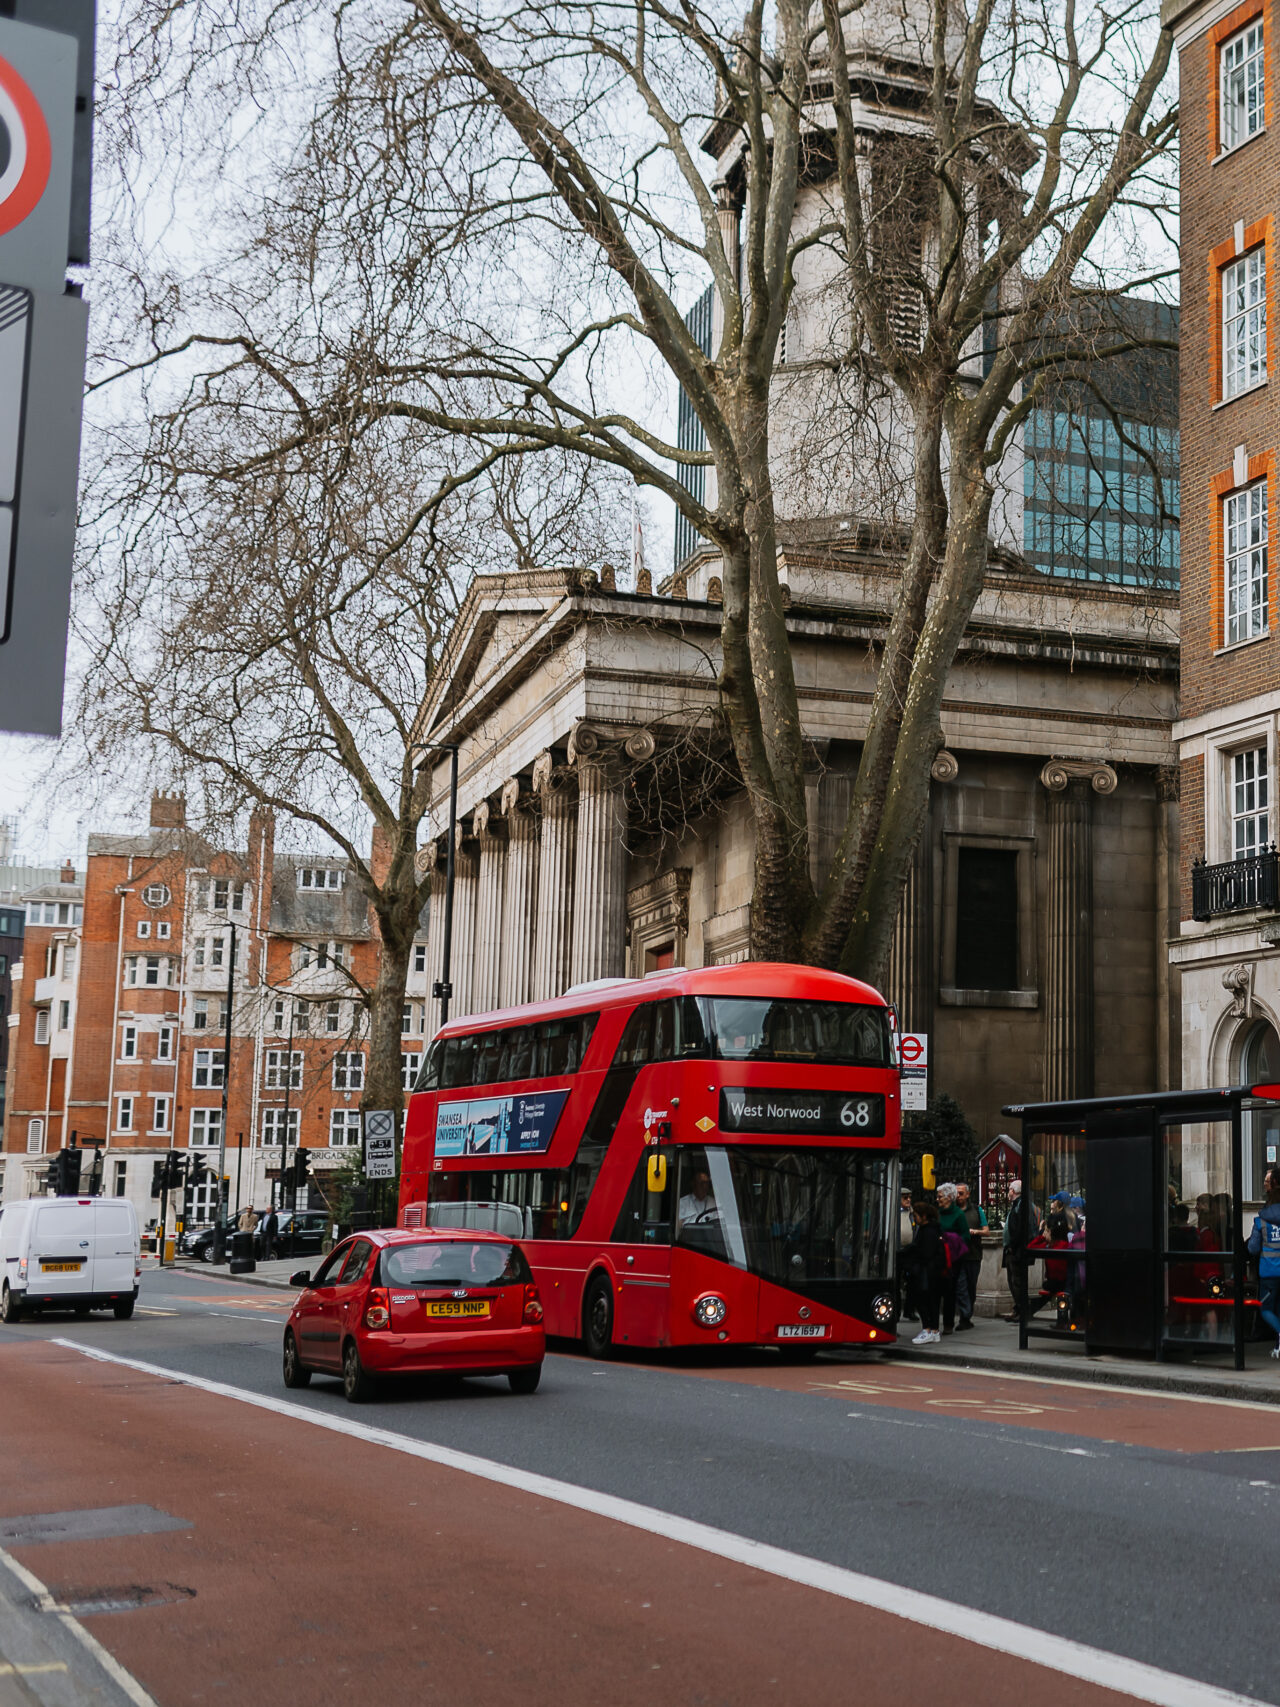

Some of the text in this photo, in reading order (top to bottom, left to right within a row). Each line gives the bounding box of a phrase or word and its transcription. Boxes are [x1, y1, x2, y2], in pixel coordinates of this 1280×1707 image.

[438, 1113, 462, 1126] SWANSEA
[731, 1101, 869, 1126] West Norwood 68
[437, 1127, 467, 1140] UNIVERSITY
[311, 1152, 348, 1160] BRIGADE
[431, 1303, 485, 1314] CE59 NNP
[783, 1326, 820, 1336] LTZ 1697
